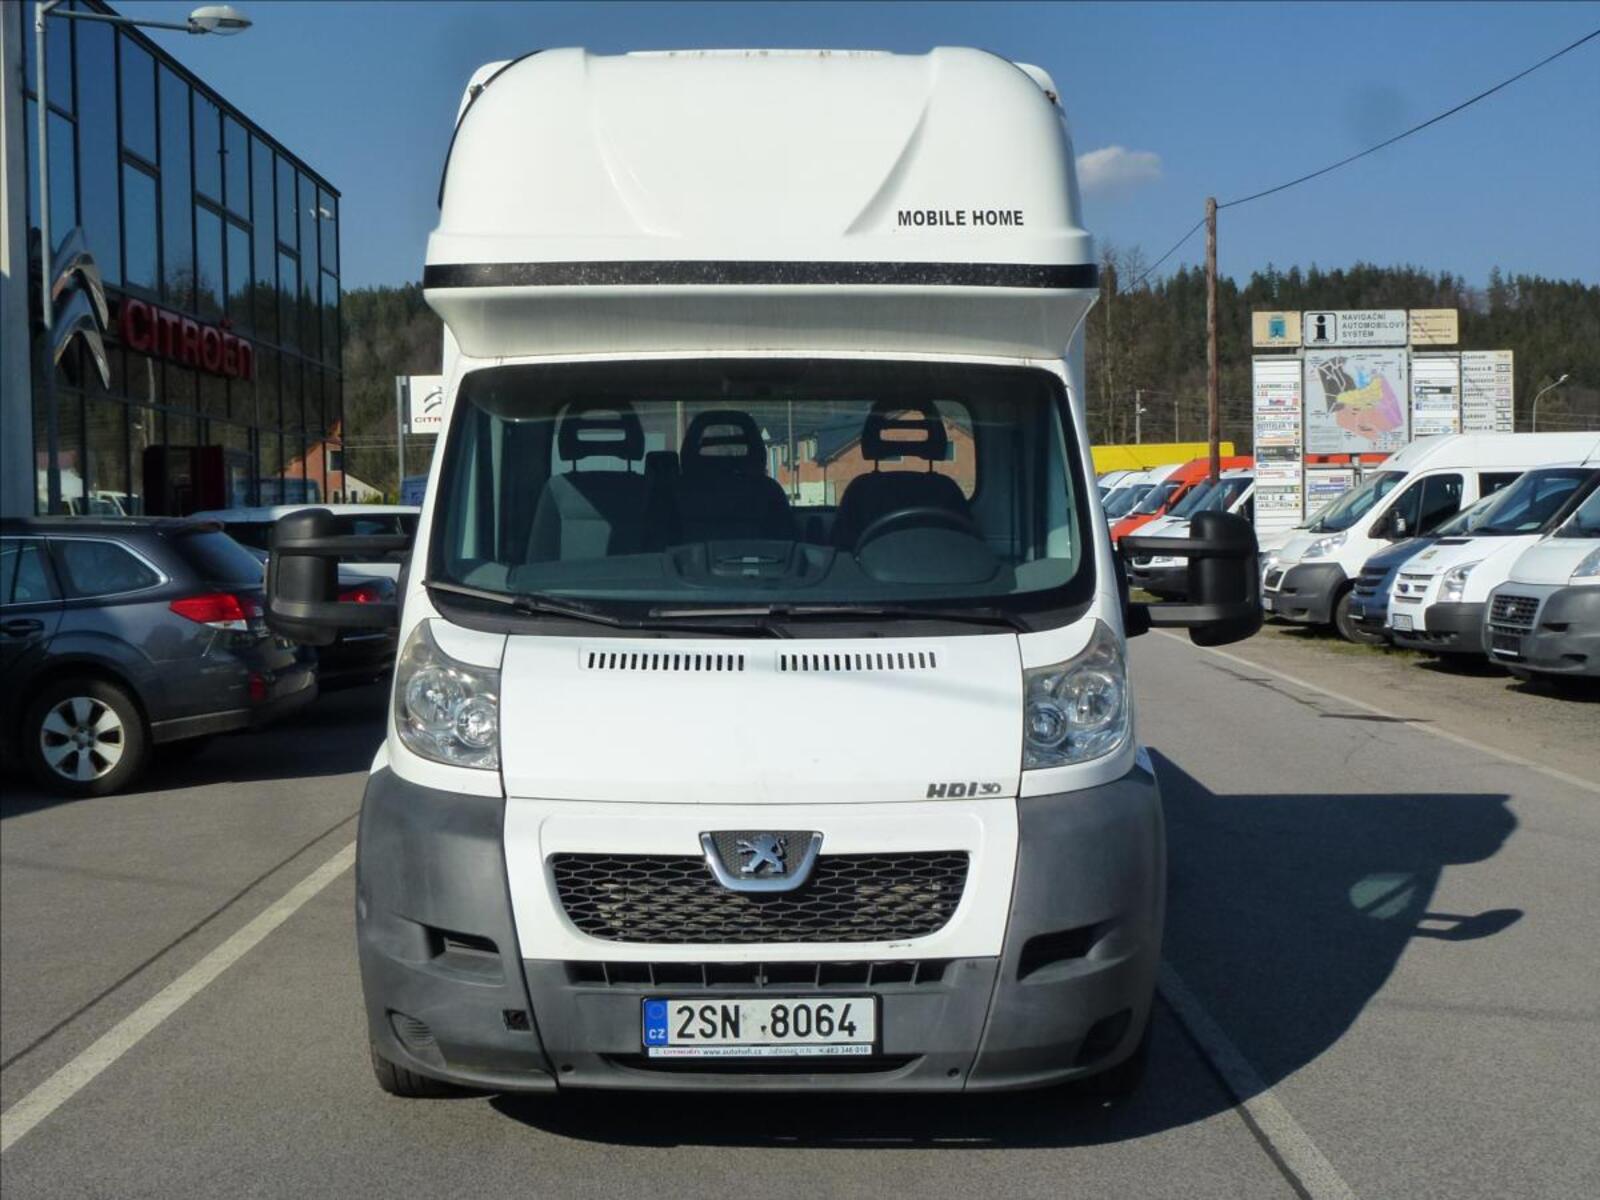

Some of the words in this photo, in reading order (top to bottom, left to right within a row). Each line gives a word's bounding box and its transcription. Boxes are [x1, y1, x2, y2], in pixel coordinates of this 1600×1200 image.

[898, 209, 966, 226] MOBILE
[972, 209, 1024, 226] HOME
[121, 297, 253, 380] CITROËN
[648, 1028, 666, 1040] CZ
[676, 1004, 740, 1039] 2SN
[770, 1003, 857, 1038] 8064
